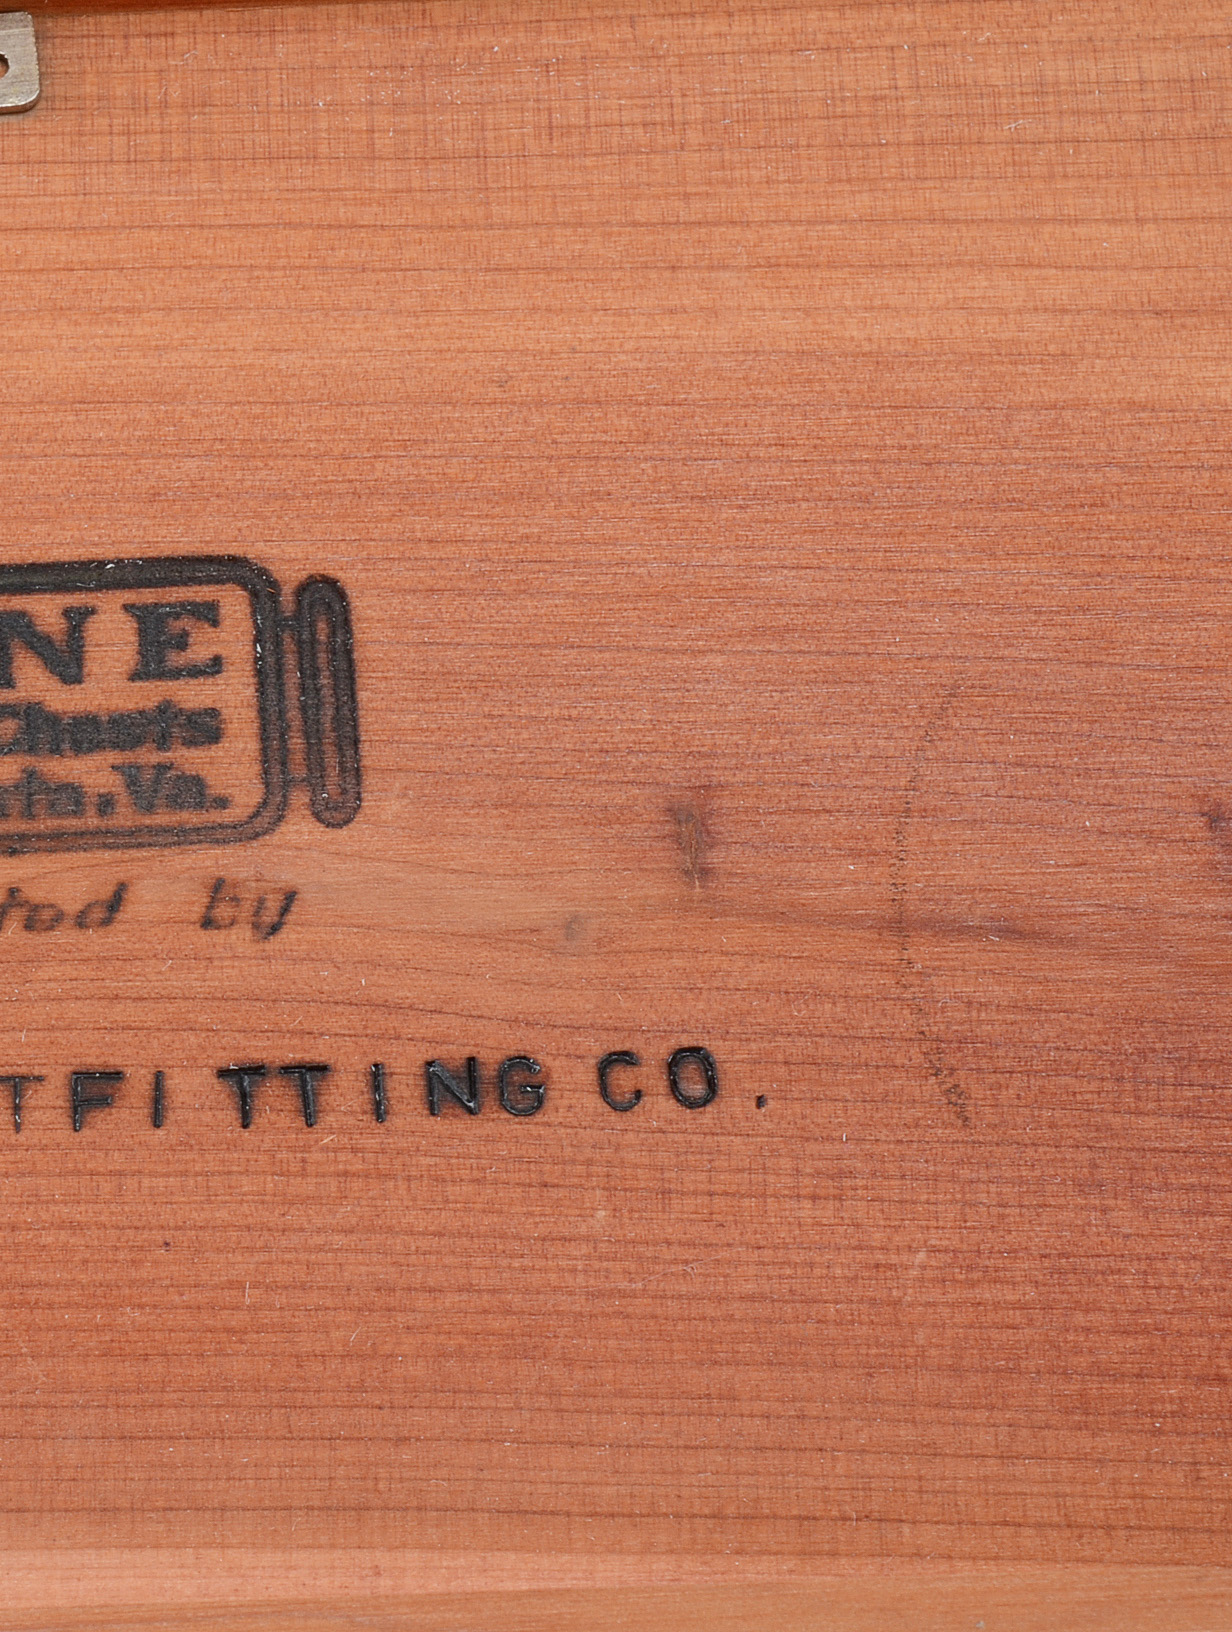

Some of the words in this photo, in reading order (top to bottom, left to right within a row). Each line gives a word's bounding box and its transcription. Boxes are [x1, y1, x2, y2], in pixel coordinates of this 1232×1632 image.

[111, 762, 231, 814] Va.
[199, 877, 297, 940] by
[597, 1045, 768, 1112] CO.
